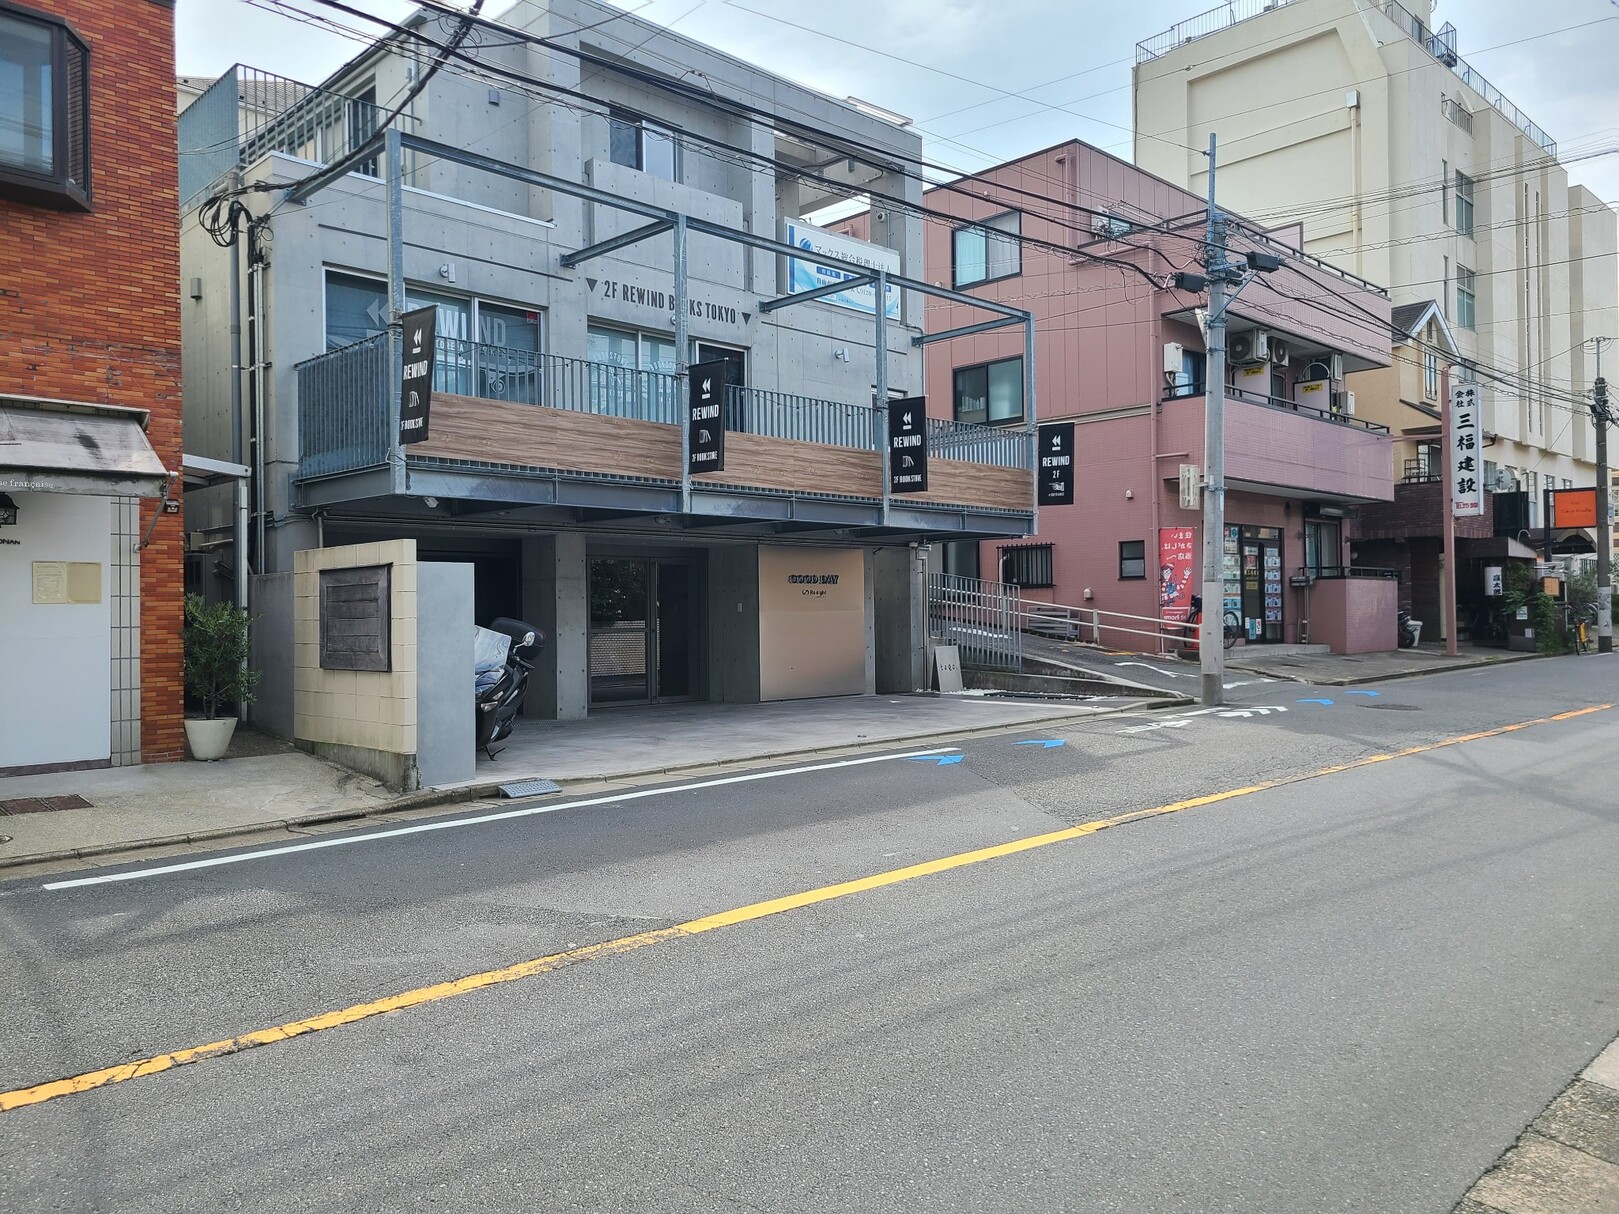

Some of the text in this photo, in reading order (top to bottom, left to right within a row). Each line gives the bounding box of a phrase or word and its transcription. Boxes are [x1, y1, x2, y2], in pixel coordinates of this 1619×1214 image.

[604, 280, 737, 325] 2F REWIND BKS TOKYO
[403, 360, 428, 380] REWIND
[692, 404, 720, 421] REWIND
[893, 434, 922, 449] REWIND
[1042, 455, 1070, 467] REWIND
[1456, 413, 1477, 494] 三福建設
[1052, 470, 1060, 479] 2F
[9, 478, 54, 490] française
[788, 574, 840, 585] GOOD DAY
